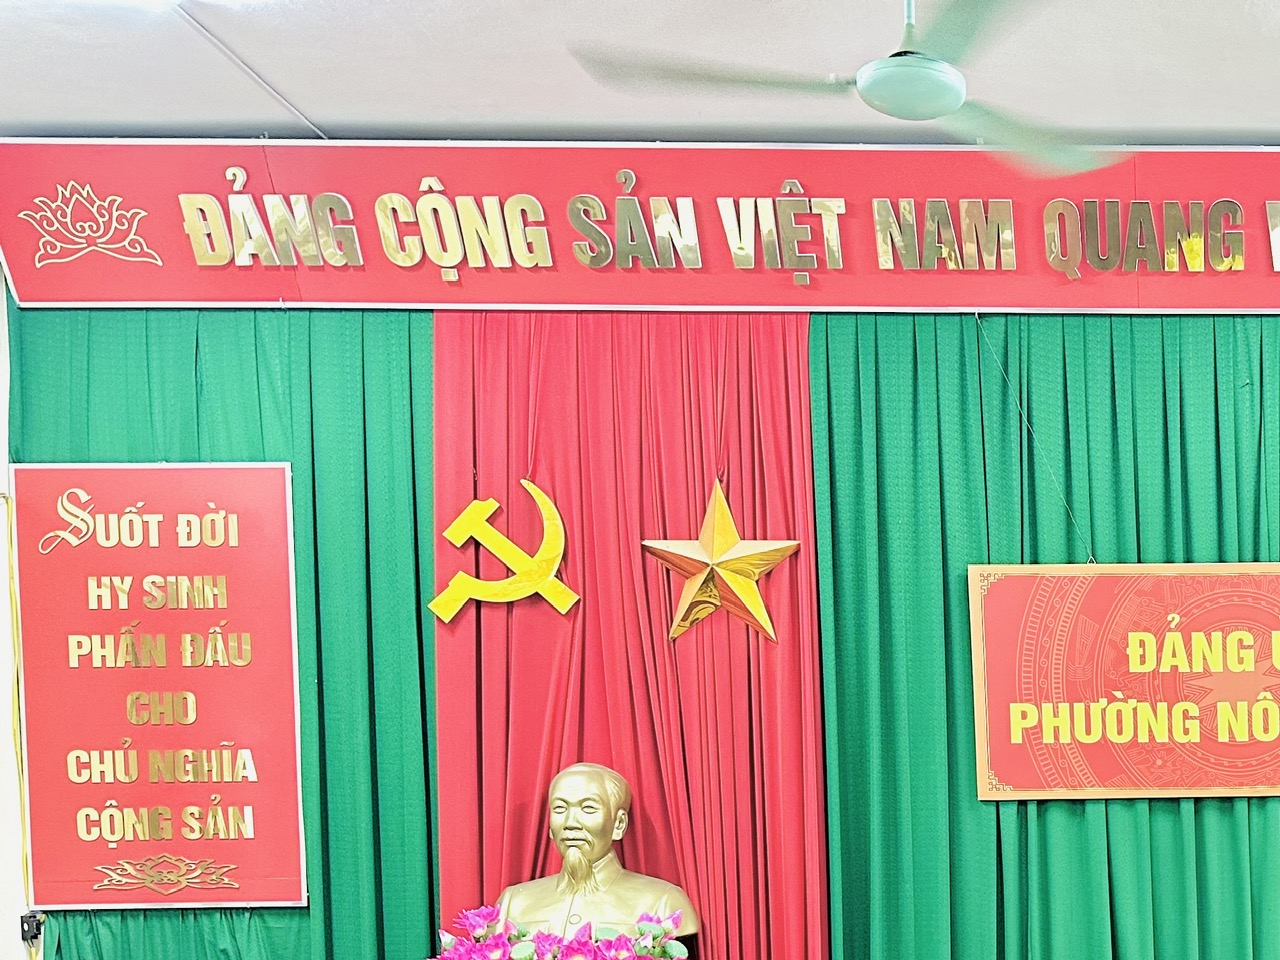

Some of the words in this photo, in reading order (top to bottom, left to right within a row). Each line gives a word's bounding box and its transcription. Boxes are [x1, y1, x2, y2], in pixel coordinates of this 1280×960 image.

[180, 167, 365, 269] ĐẢNG
[376, 175, 555, 281] CỘNG
[570, 169, 701, 270] SẢN
[717, 180, 847, 285] VIỆT
[872, 197, 1018, 272] NAM
[1043, 197, 1246, 279] QUANG
[38, 488, 163, 554] SUỐT
[176, 503, 240, 548] ĐỜI
[87, 576, 133, 610] HY
[142, 574, 227, 610] SINH
[68, 620, 167, 668] PHẤN
[180, 620, 253, 667] ĐẤU
[1126, 613, 1258, 674] ĐẢNG
[126, 691, 198, 725] CHO
[1008, 690, 1201, 745] PHƯỜNG
[66, 738, 139, 784] CHỦ
[148, 742, 259, 783] NGHĨA
[76, 800, 172, 849] CỘNG
[181, 794, 255, 841] SẢN
